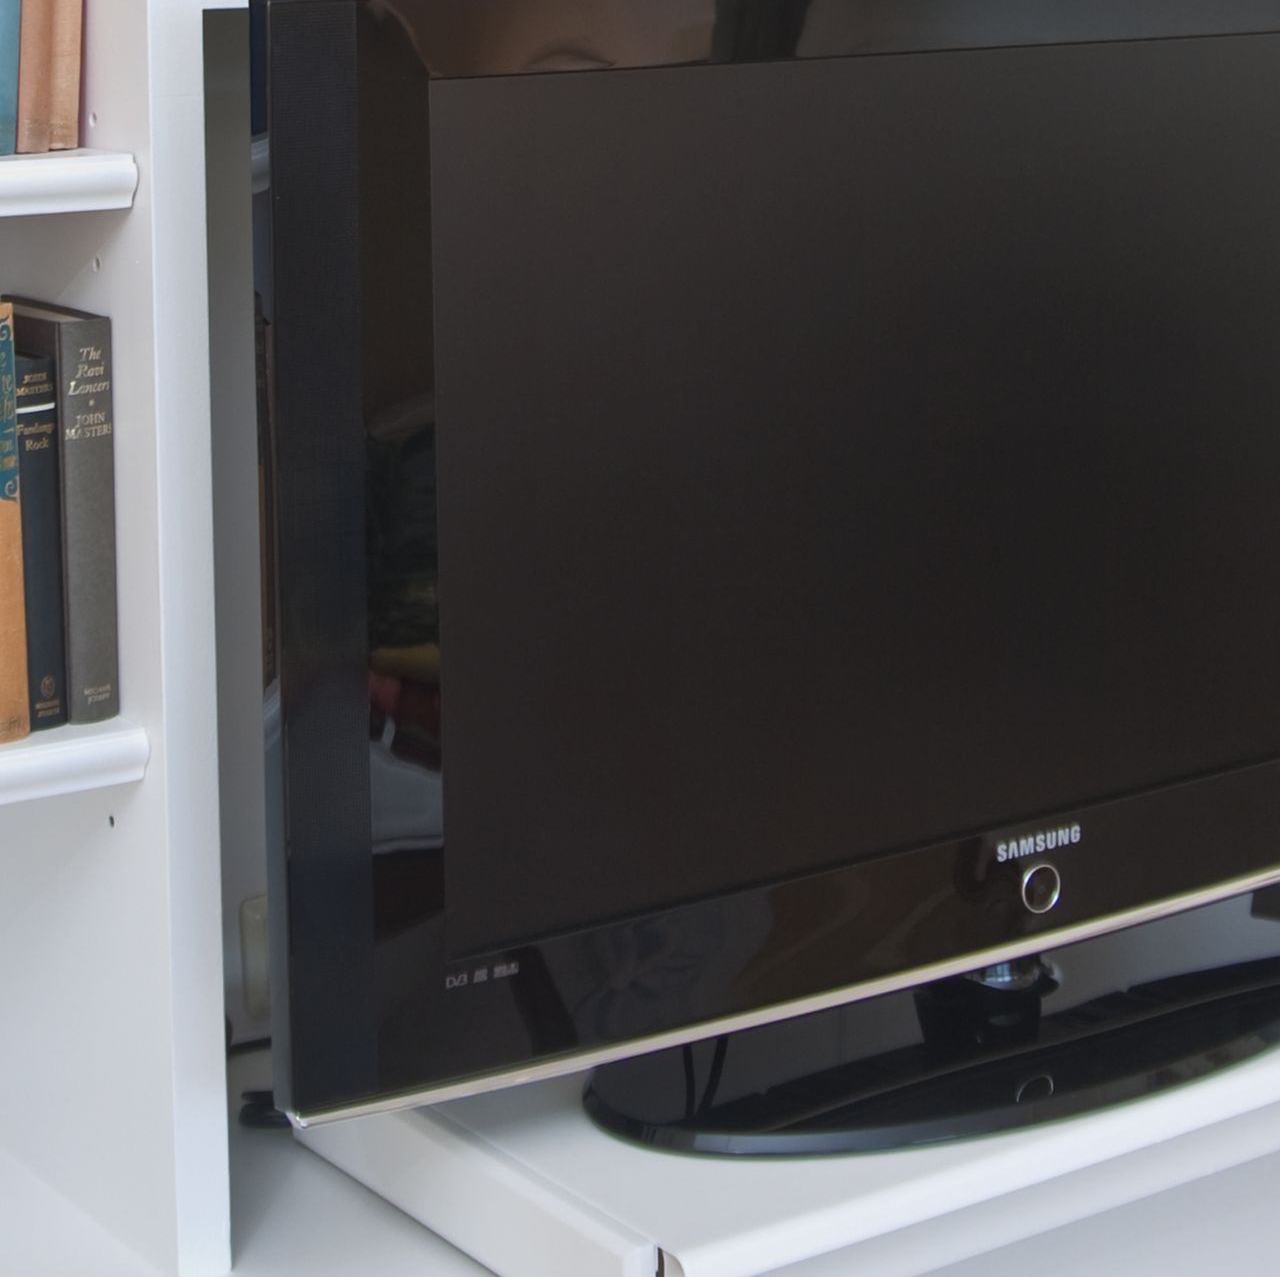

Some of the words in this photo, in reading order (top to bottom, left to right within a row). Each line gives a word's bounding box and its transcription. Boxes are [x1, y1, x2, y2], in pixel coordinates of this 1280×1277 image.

[80, 347, 101, 361] The
[75, 362, 104, 378] Ravi
[68, 380, 110, 396] Lancers
[76, 412, 105, 428] JOHN
[996, 823, 1082, 863] SAMSUNG
